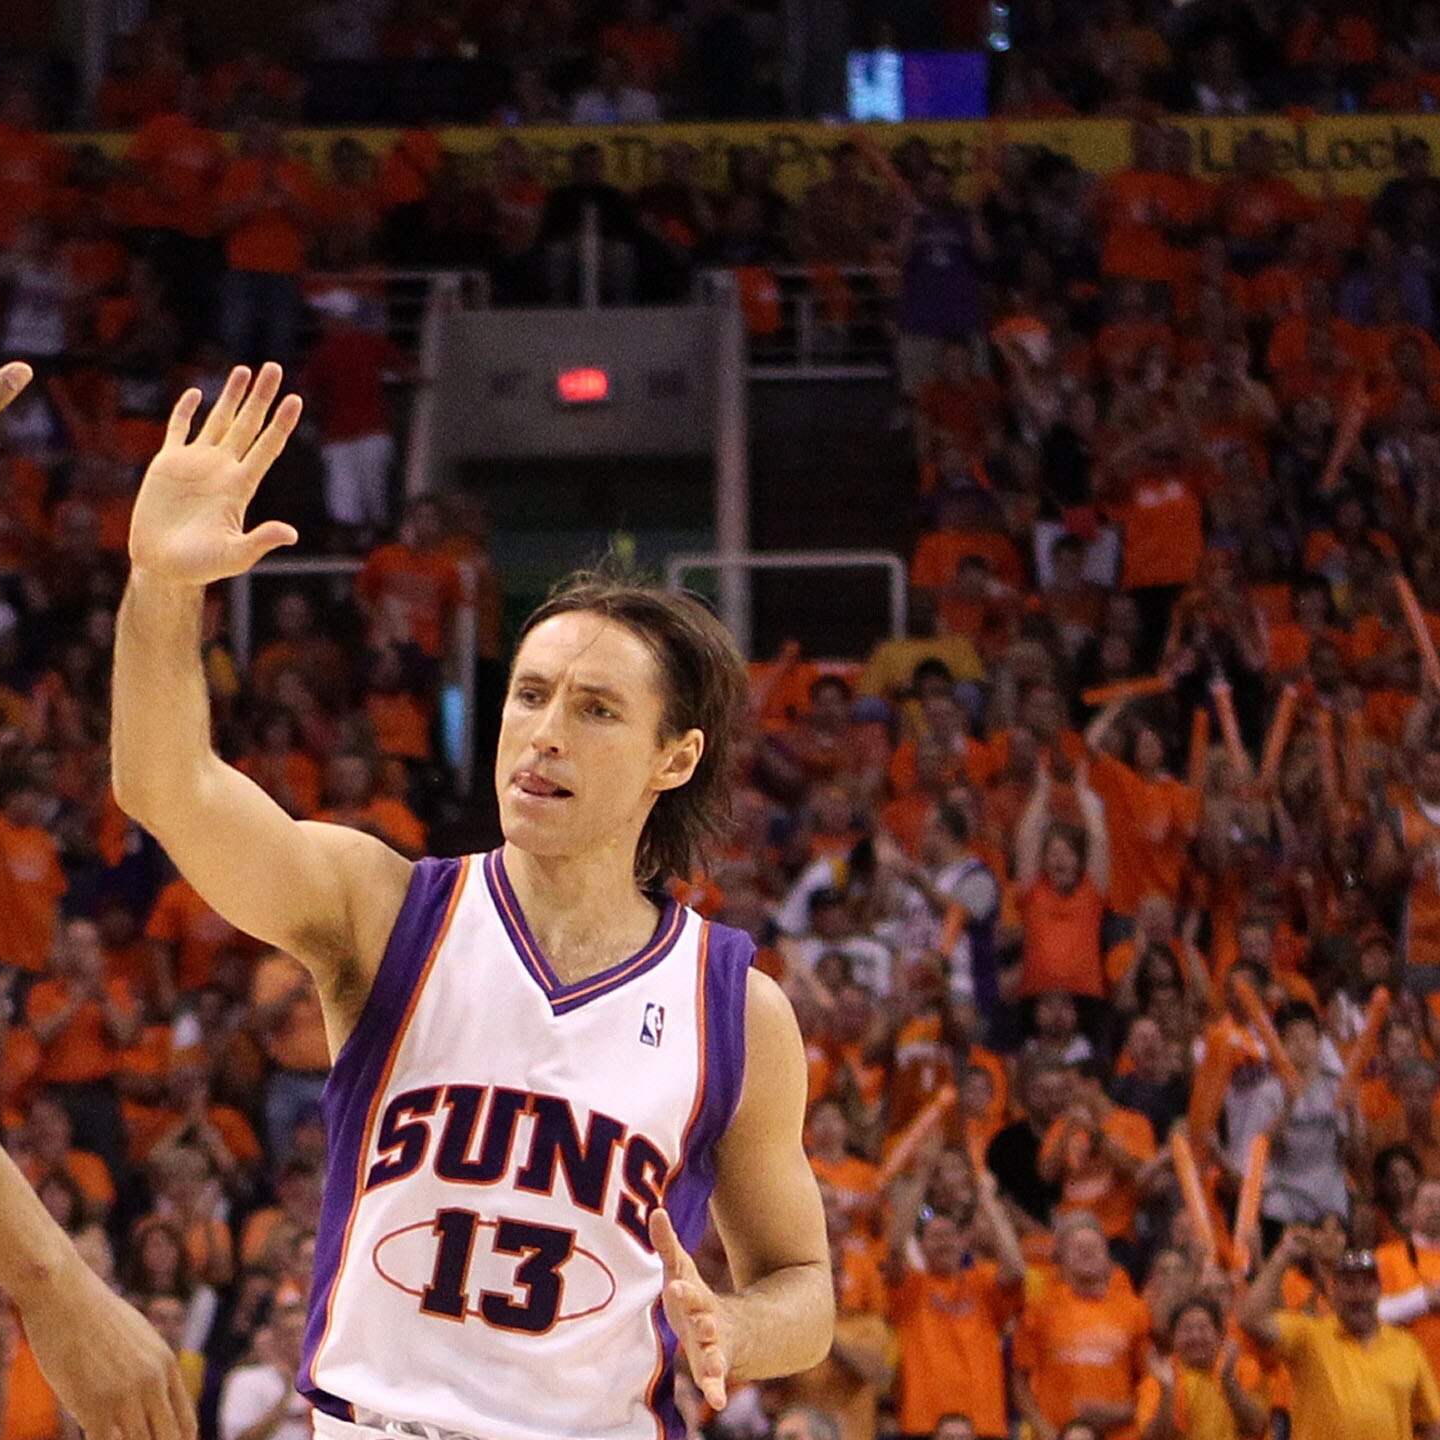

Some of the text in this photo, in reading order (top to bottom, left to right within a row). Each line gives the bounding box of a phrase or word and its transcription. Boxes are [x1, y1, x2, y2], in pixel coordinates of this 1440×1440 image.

[1198, 122, 1416, 173] LeLoc
[360, 1083, 672, 1255] SUNS
[419, 1206, 578, 1337] 13
